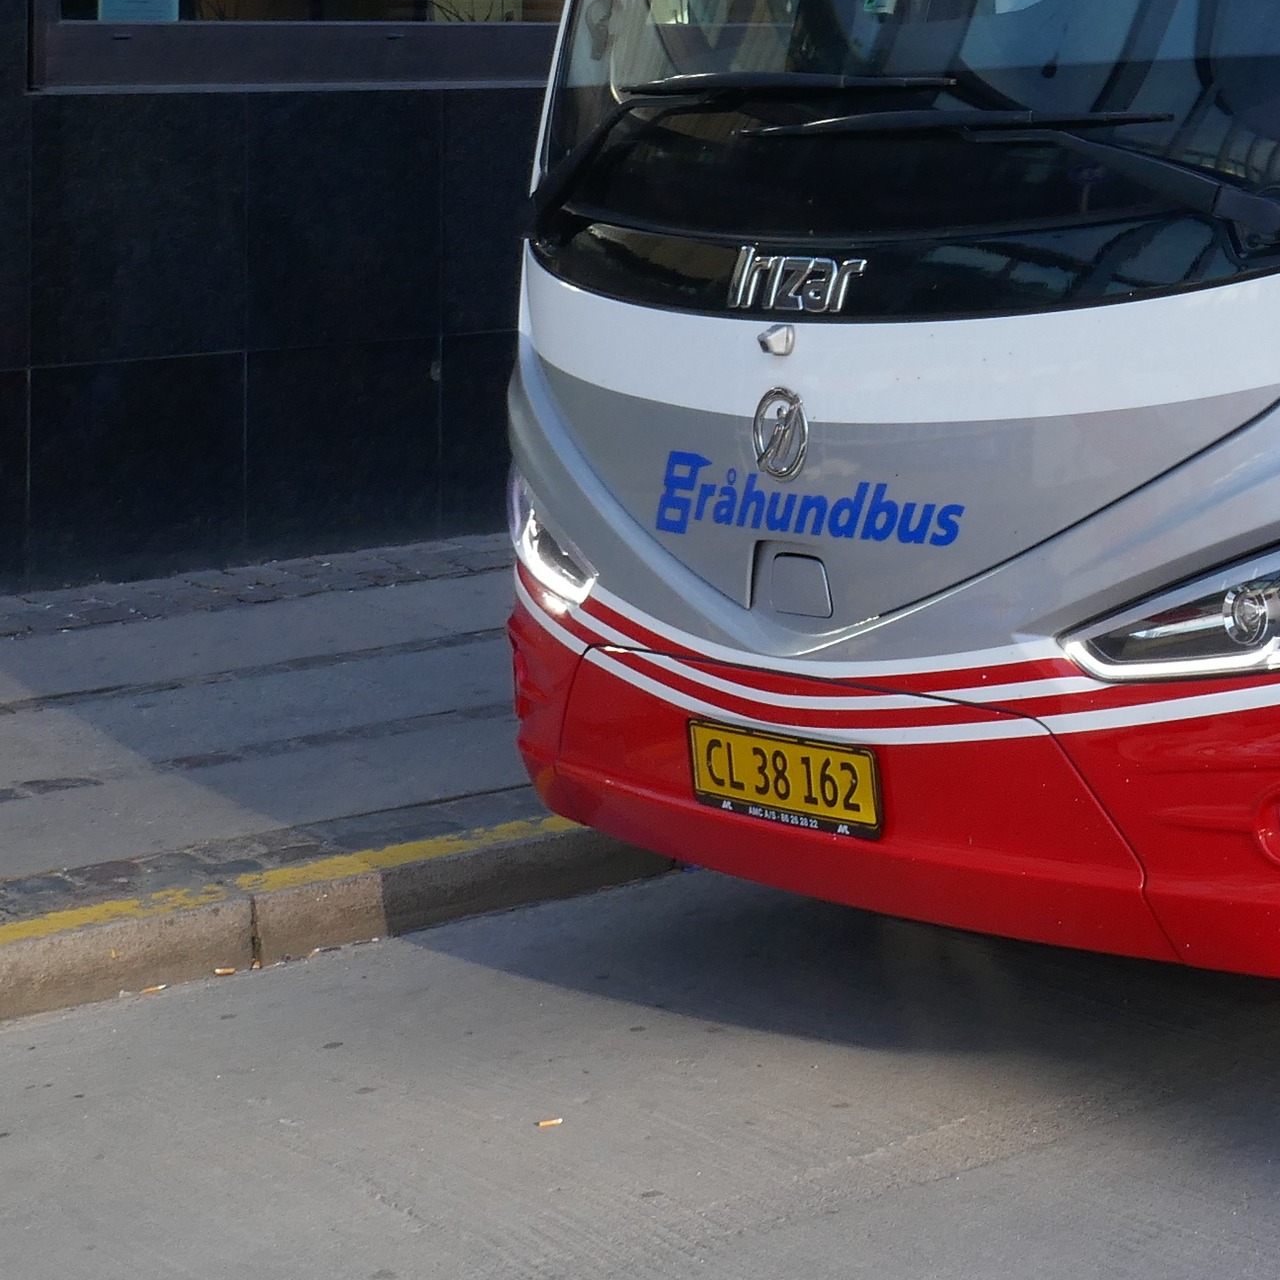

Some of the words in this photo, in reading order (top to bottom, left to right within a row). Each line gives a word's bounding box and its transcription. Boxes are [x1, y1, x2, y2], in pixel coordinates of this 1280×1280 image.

[726, 244, 868, 313] Irizar
[706, 738, 745, 792] CL
[752, 747, 791, 801] 38
[801, 756, 861, 813] 162
